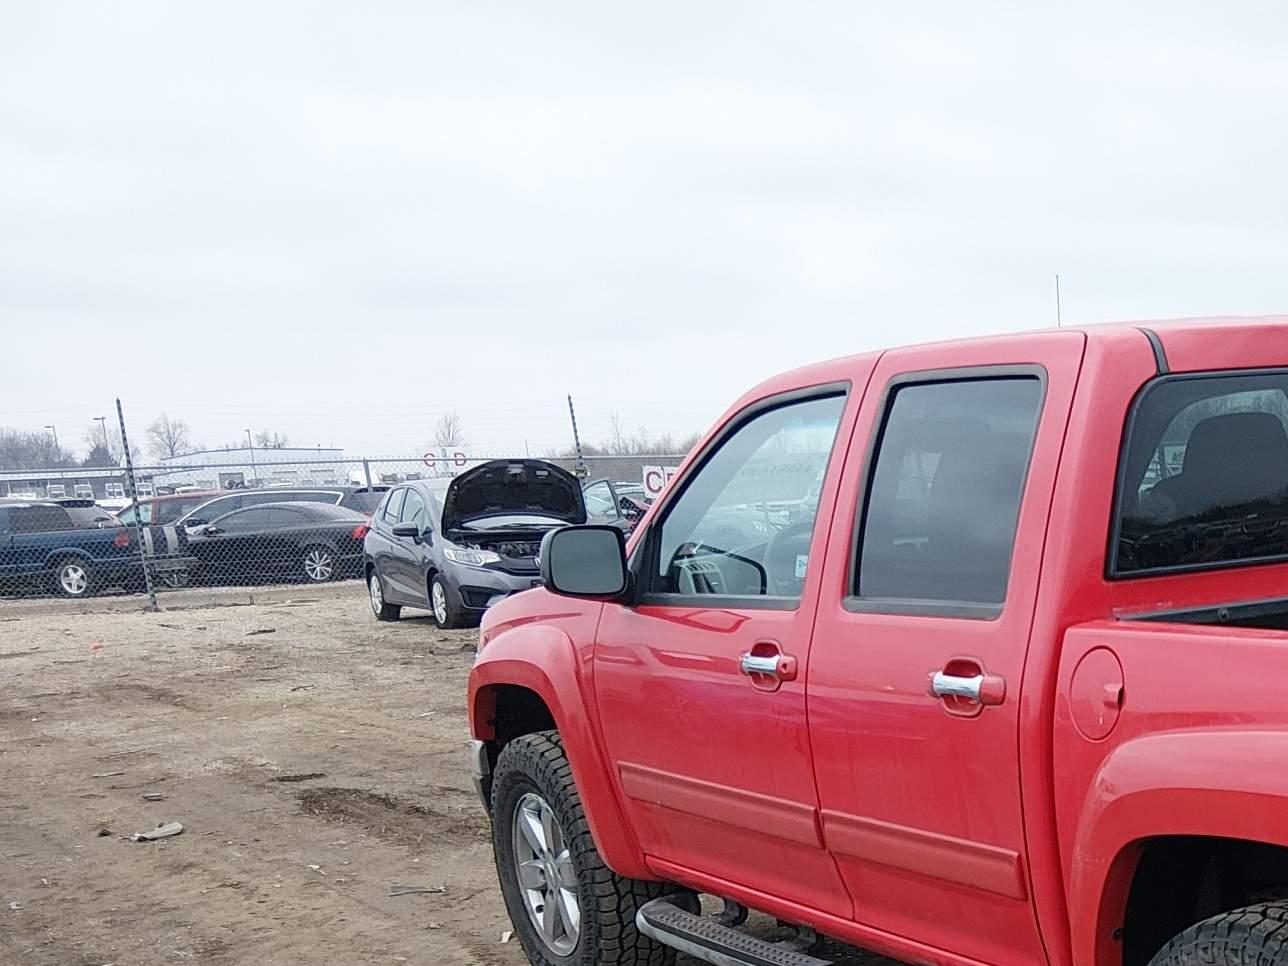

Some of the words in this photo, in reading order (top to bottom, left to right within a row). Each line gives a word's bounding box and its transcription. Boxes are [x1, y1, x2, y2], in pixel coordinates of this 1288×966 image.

[423, 452, 436, 468] C
[453, 452, 467, 467] D
[646, 471, 662, 493] C
